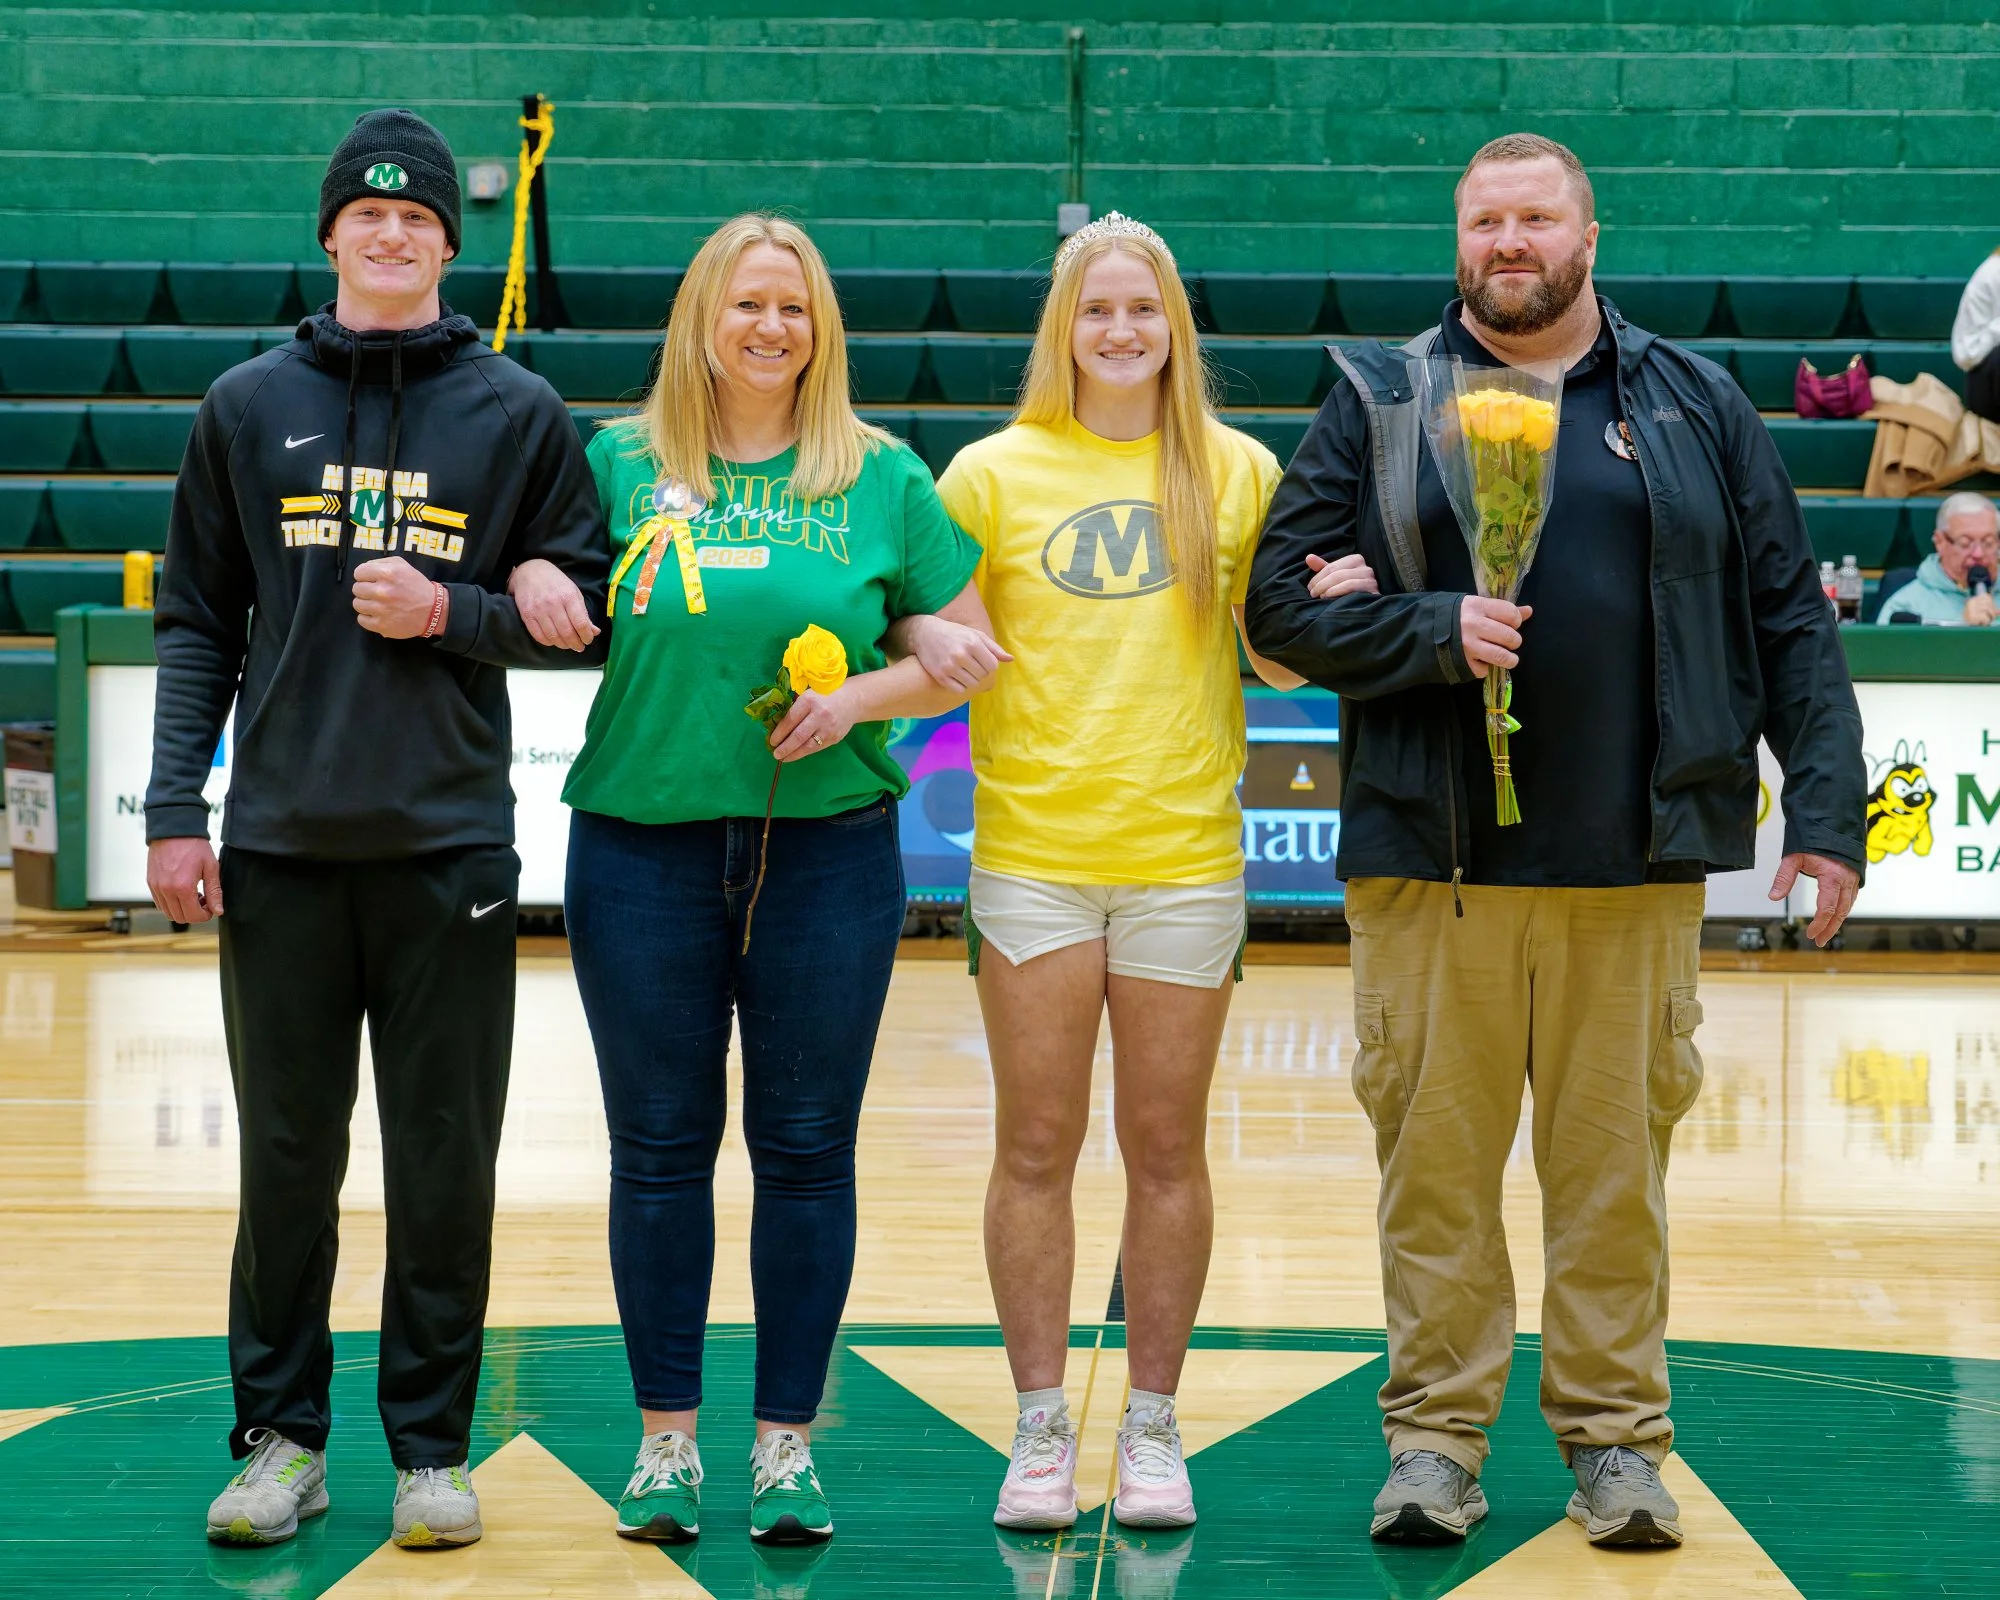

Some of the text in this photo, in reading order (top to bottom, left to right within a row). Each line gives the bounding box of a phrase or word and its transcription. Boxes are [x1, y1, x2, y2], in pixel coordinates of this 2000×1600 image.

[368, 164, 402, 188] M
[404, 525, 465, 562] FIELD
[702, 548, 765, 566] 2026
[1059, 507, 1169, 592] M
